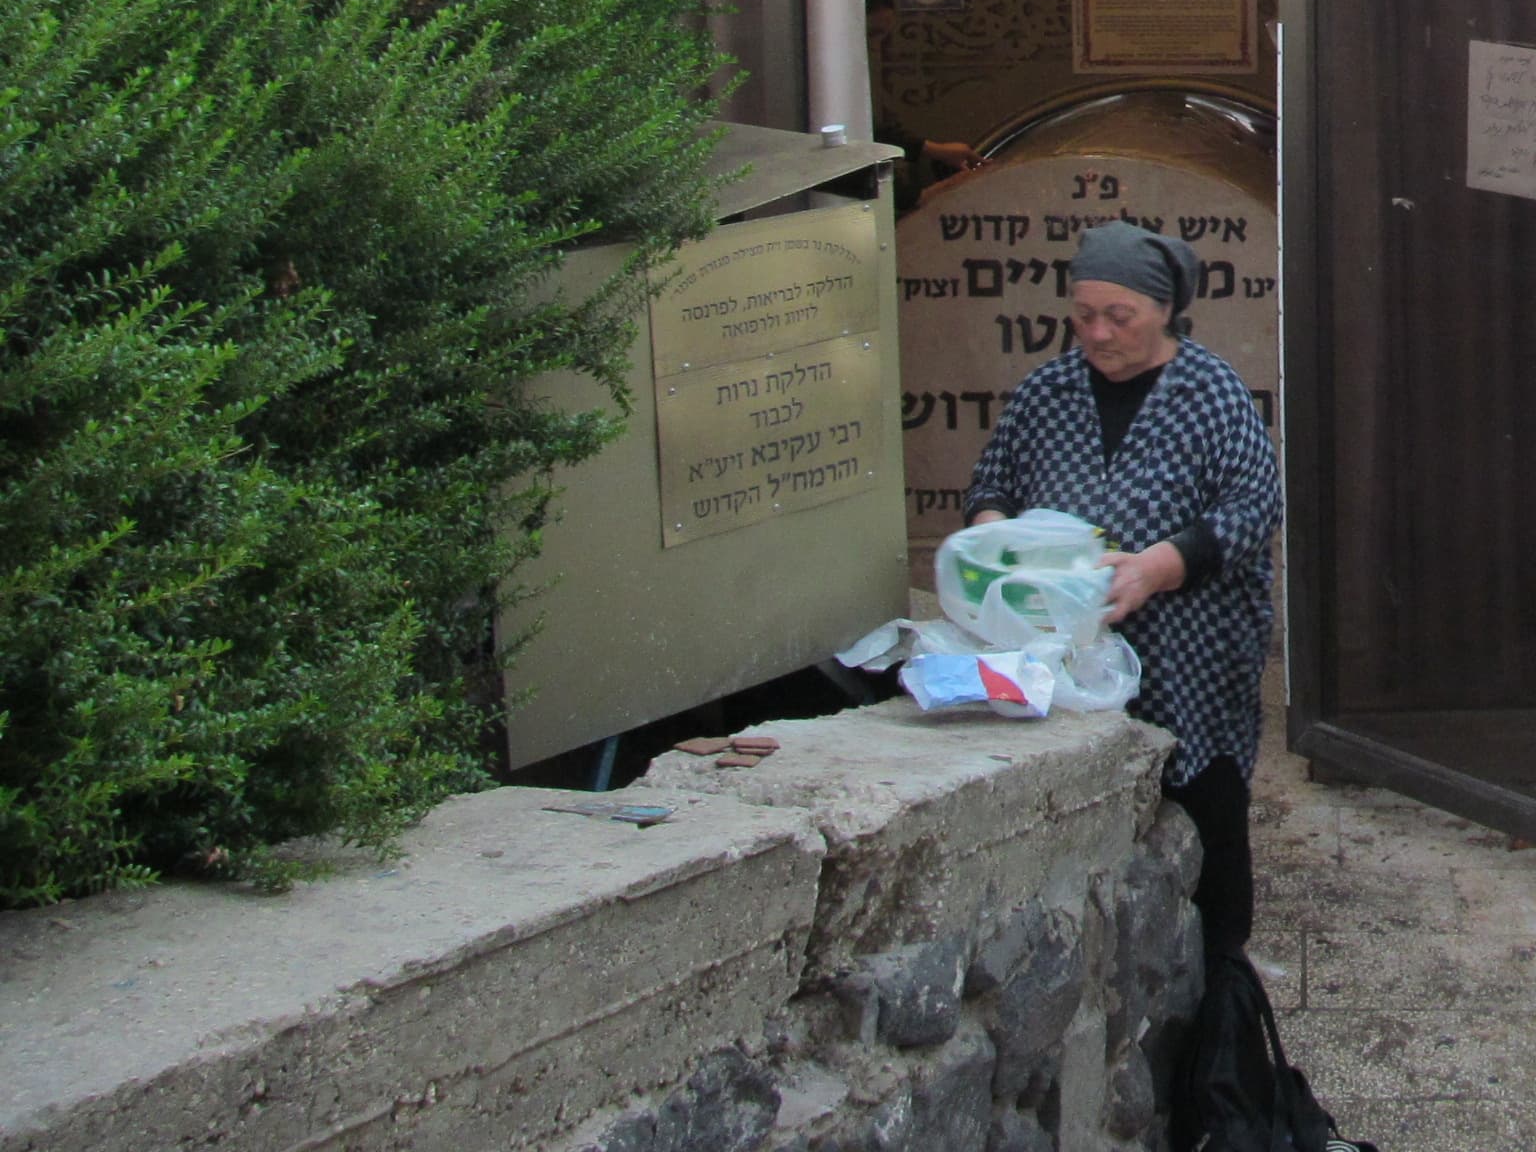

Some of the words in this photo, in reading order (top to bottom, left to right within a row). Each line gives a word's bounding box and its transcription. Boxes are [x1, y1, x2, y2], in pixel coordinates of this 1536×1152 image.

[940, 213, 1030, 245] קדוש
[1178, 216, 1247, 242] איש
[743, 282, 802, 313] לבריאות,
[807, 275, 854, 299] הדלקה
[682, 296, 738, 322] לפרנסה
[721, 312, 780, 339] ולרפואה
[717, 378, 760, 406] נרות
[765, 362, 833, 395] הדלקת
[749, 398, 804, 429] לכבוד
[829, 420, 862, 445] רבי
[751, 431, 822, 467] עקיבא
[688, 452, 745, 483] זיע"א
[767, 457, 859, 498] והרמח"ל
[693, 485, 761, 518] הקדוש
